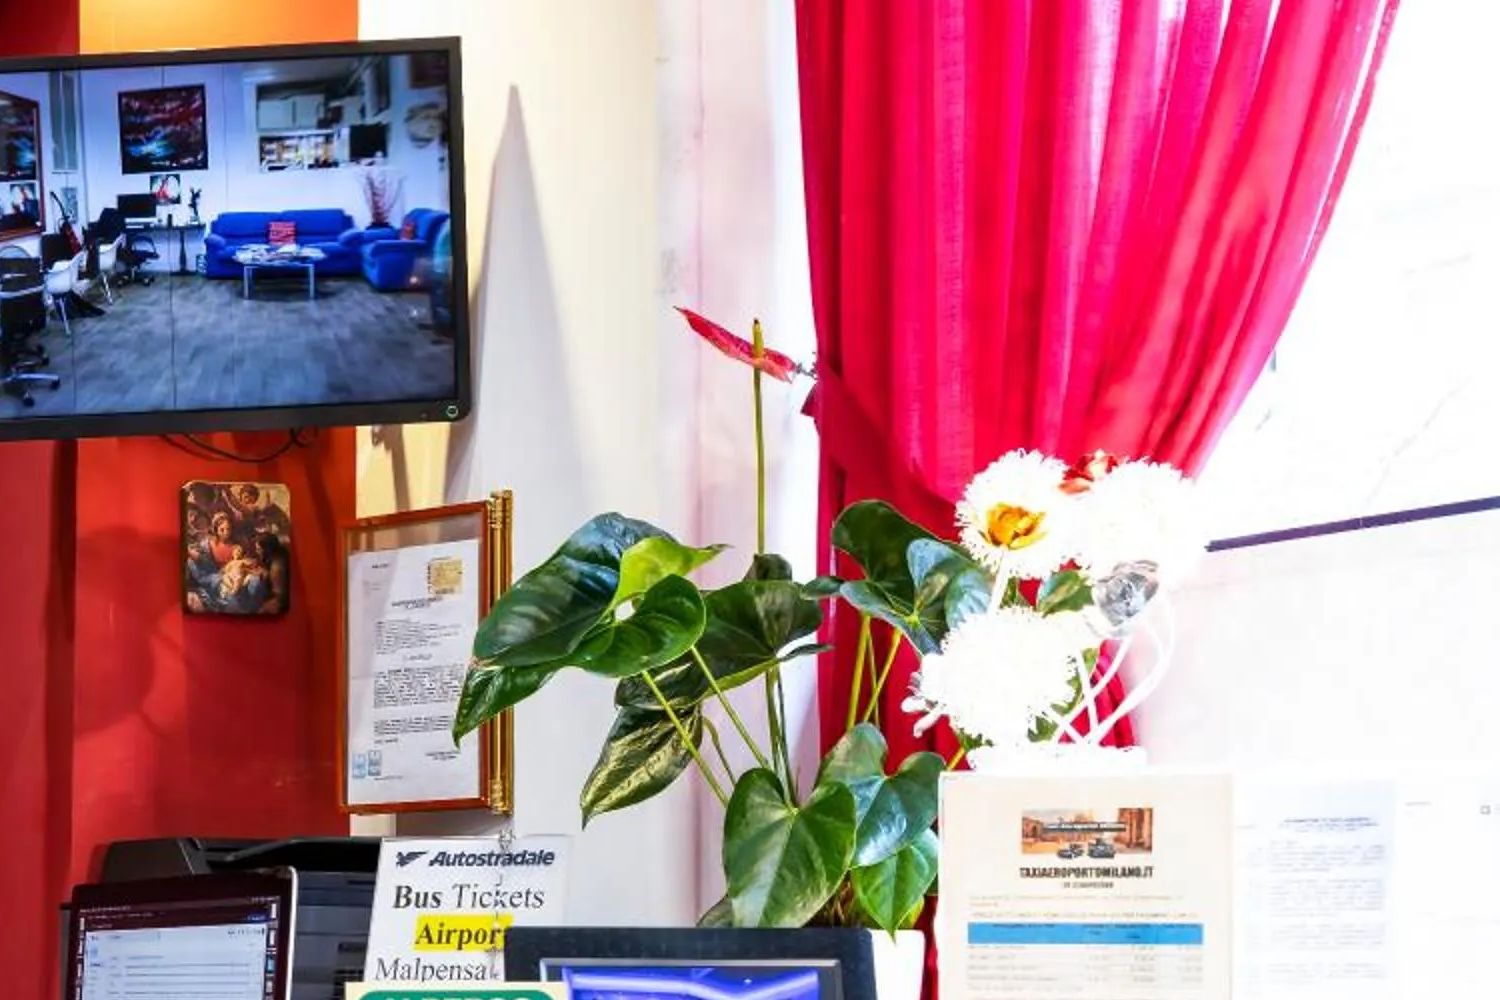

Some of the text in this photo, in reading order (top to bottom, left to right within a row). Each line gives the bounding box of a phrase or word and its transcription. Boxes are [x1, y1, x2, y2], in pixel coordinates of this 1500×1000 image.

[428, 849, 556, 867] Autostradale
[392, 882, 546, 910] Bus Tickets
[414, 921, 506, 951] Airpor
[374, 957, 486, 982] Malpensa
